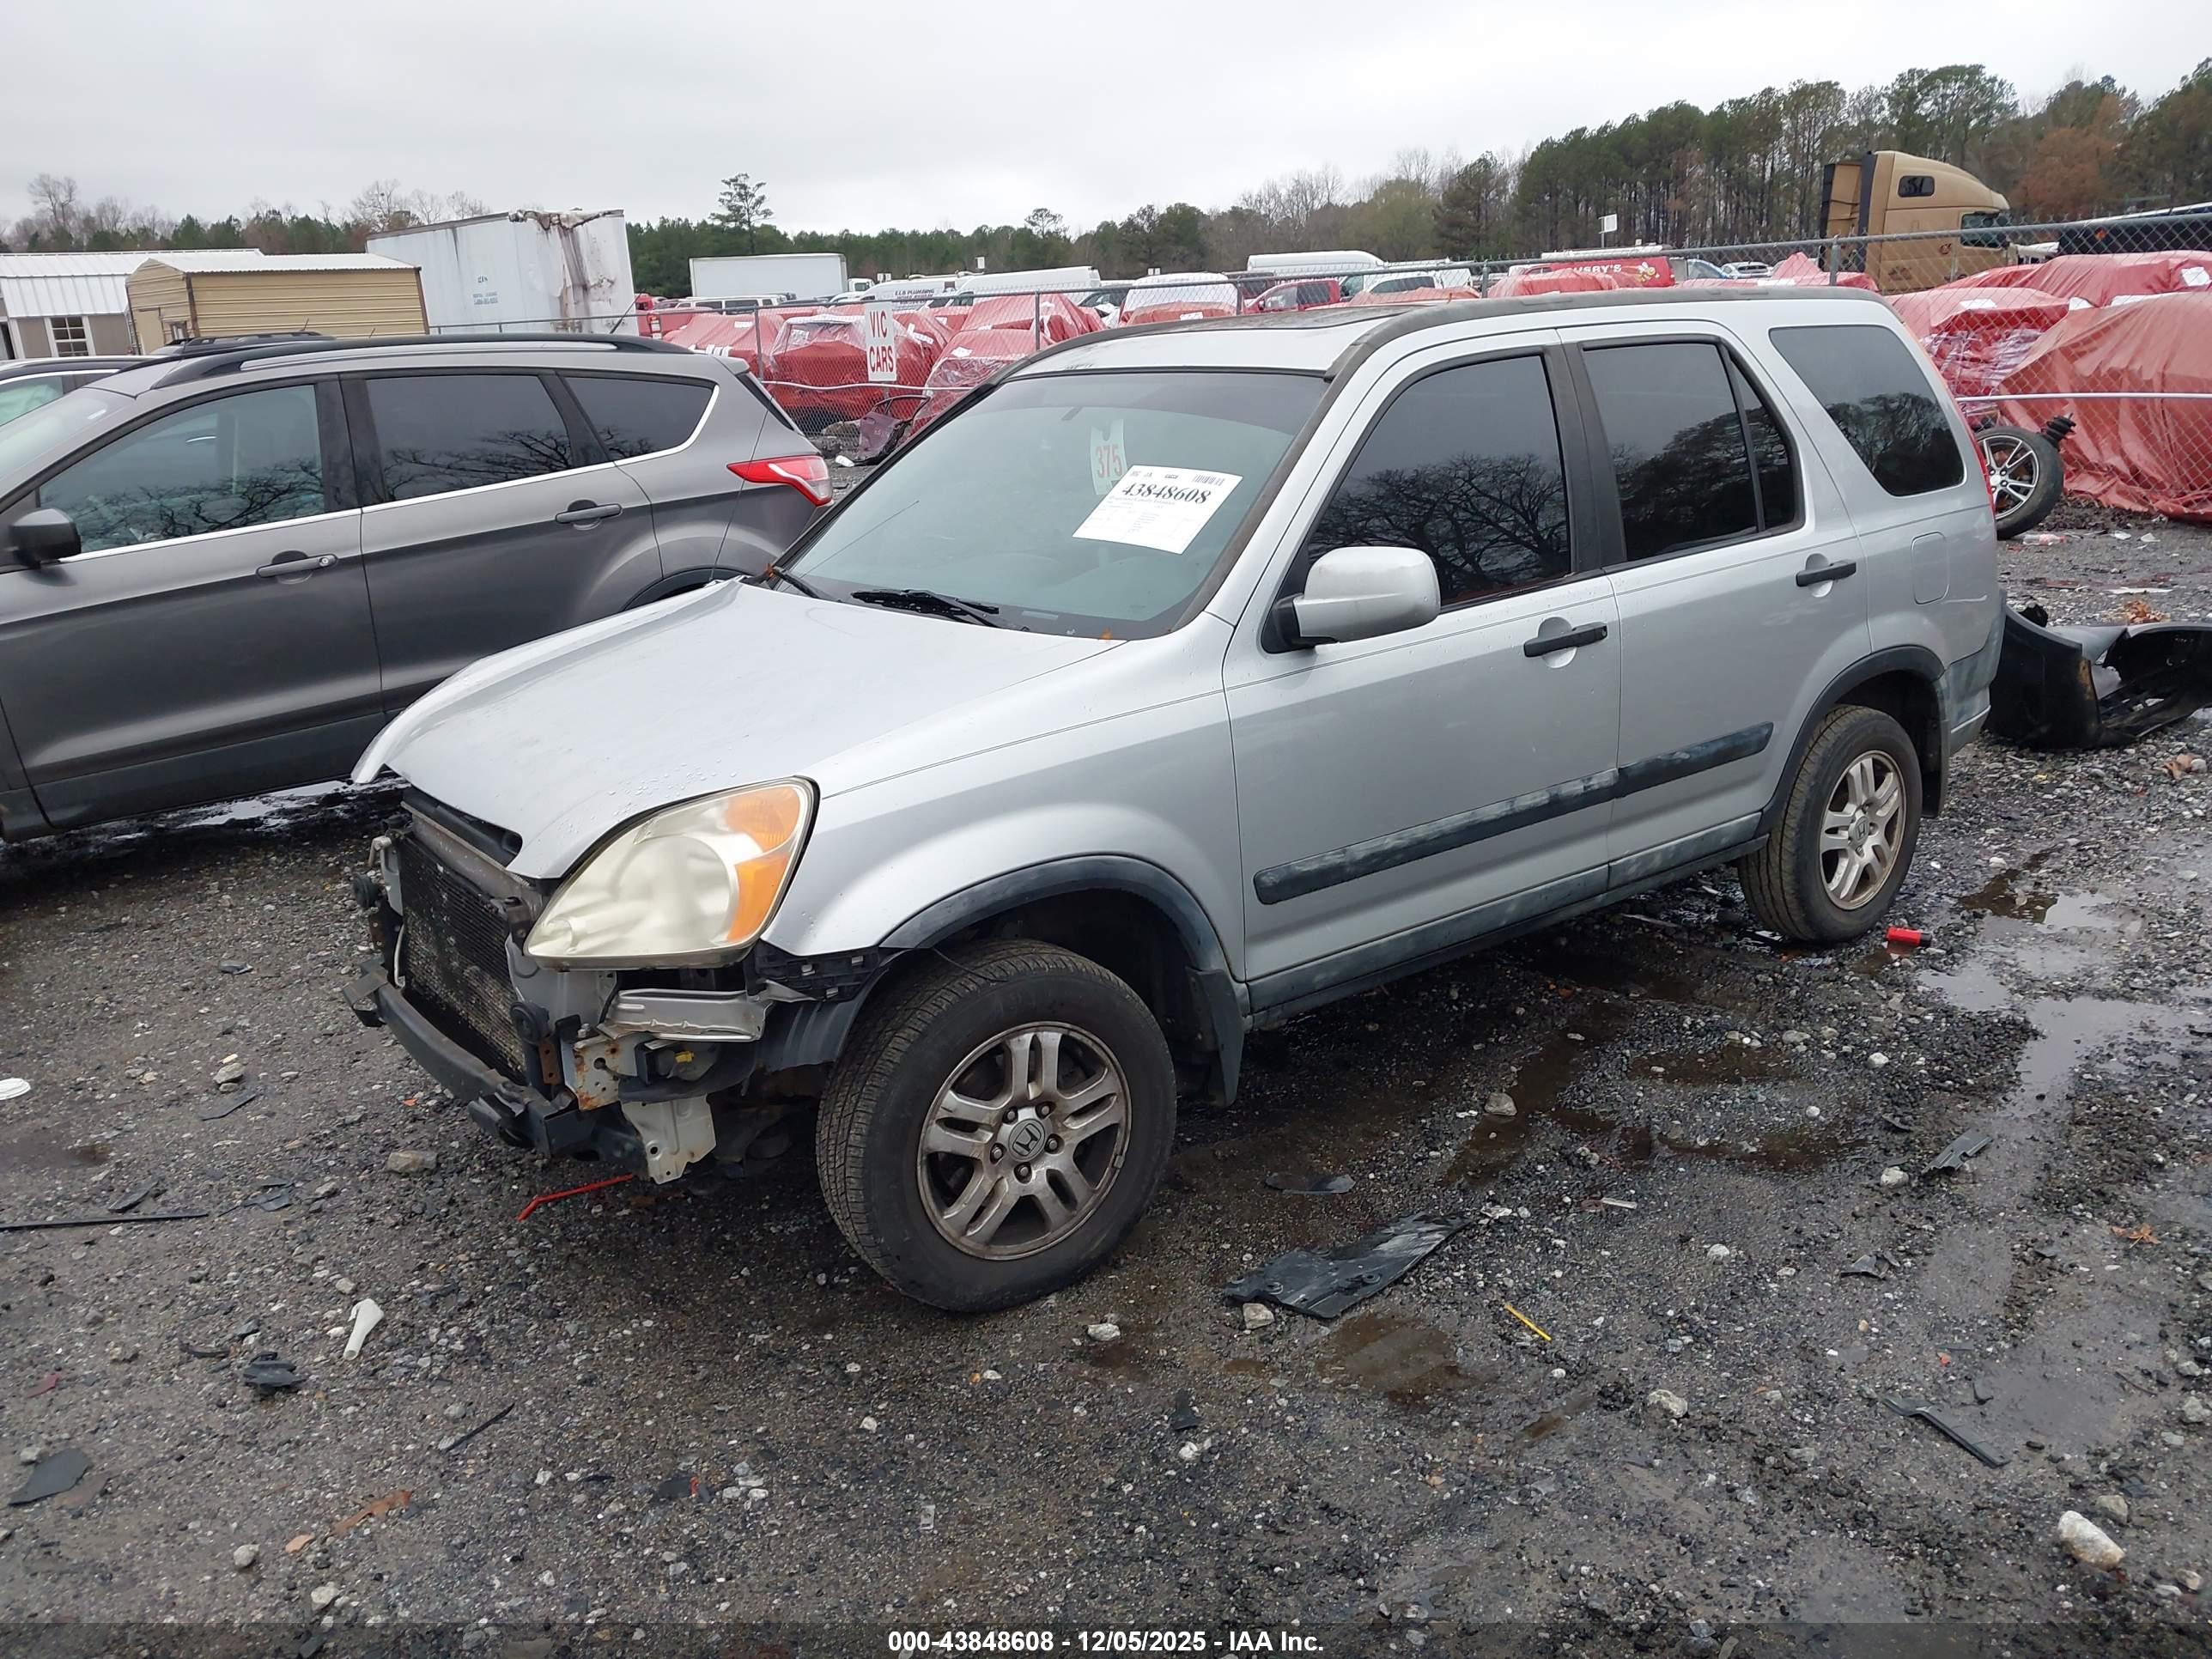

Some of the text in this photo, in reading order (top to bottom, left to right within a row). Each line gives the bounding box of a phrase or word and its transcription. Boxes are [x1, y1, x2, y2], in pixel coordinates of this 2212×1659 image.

[1573, 264, 1621, 274] USBY'S
[870, 311, 887, 337] VIC
[870, 346, 894, 372] CARS
[1096, 445, 1123, 478] 375
[1122, 483, 1212, 504] 43848608
